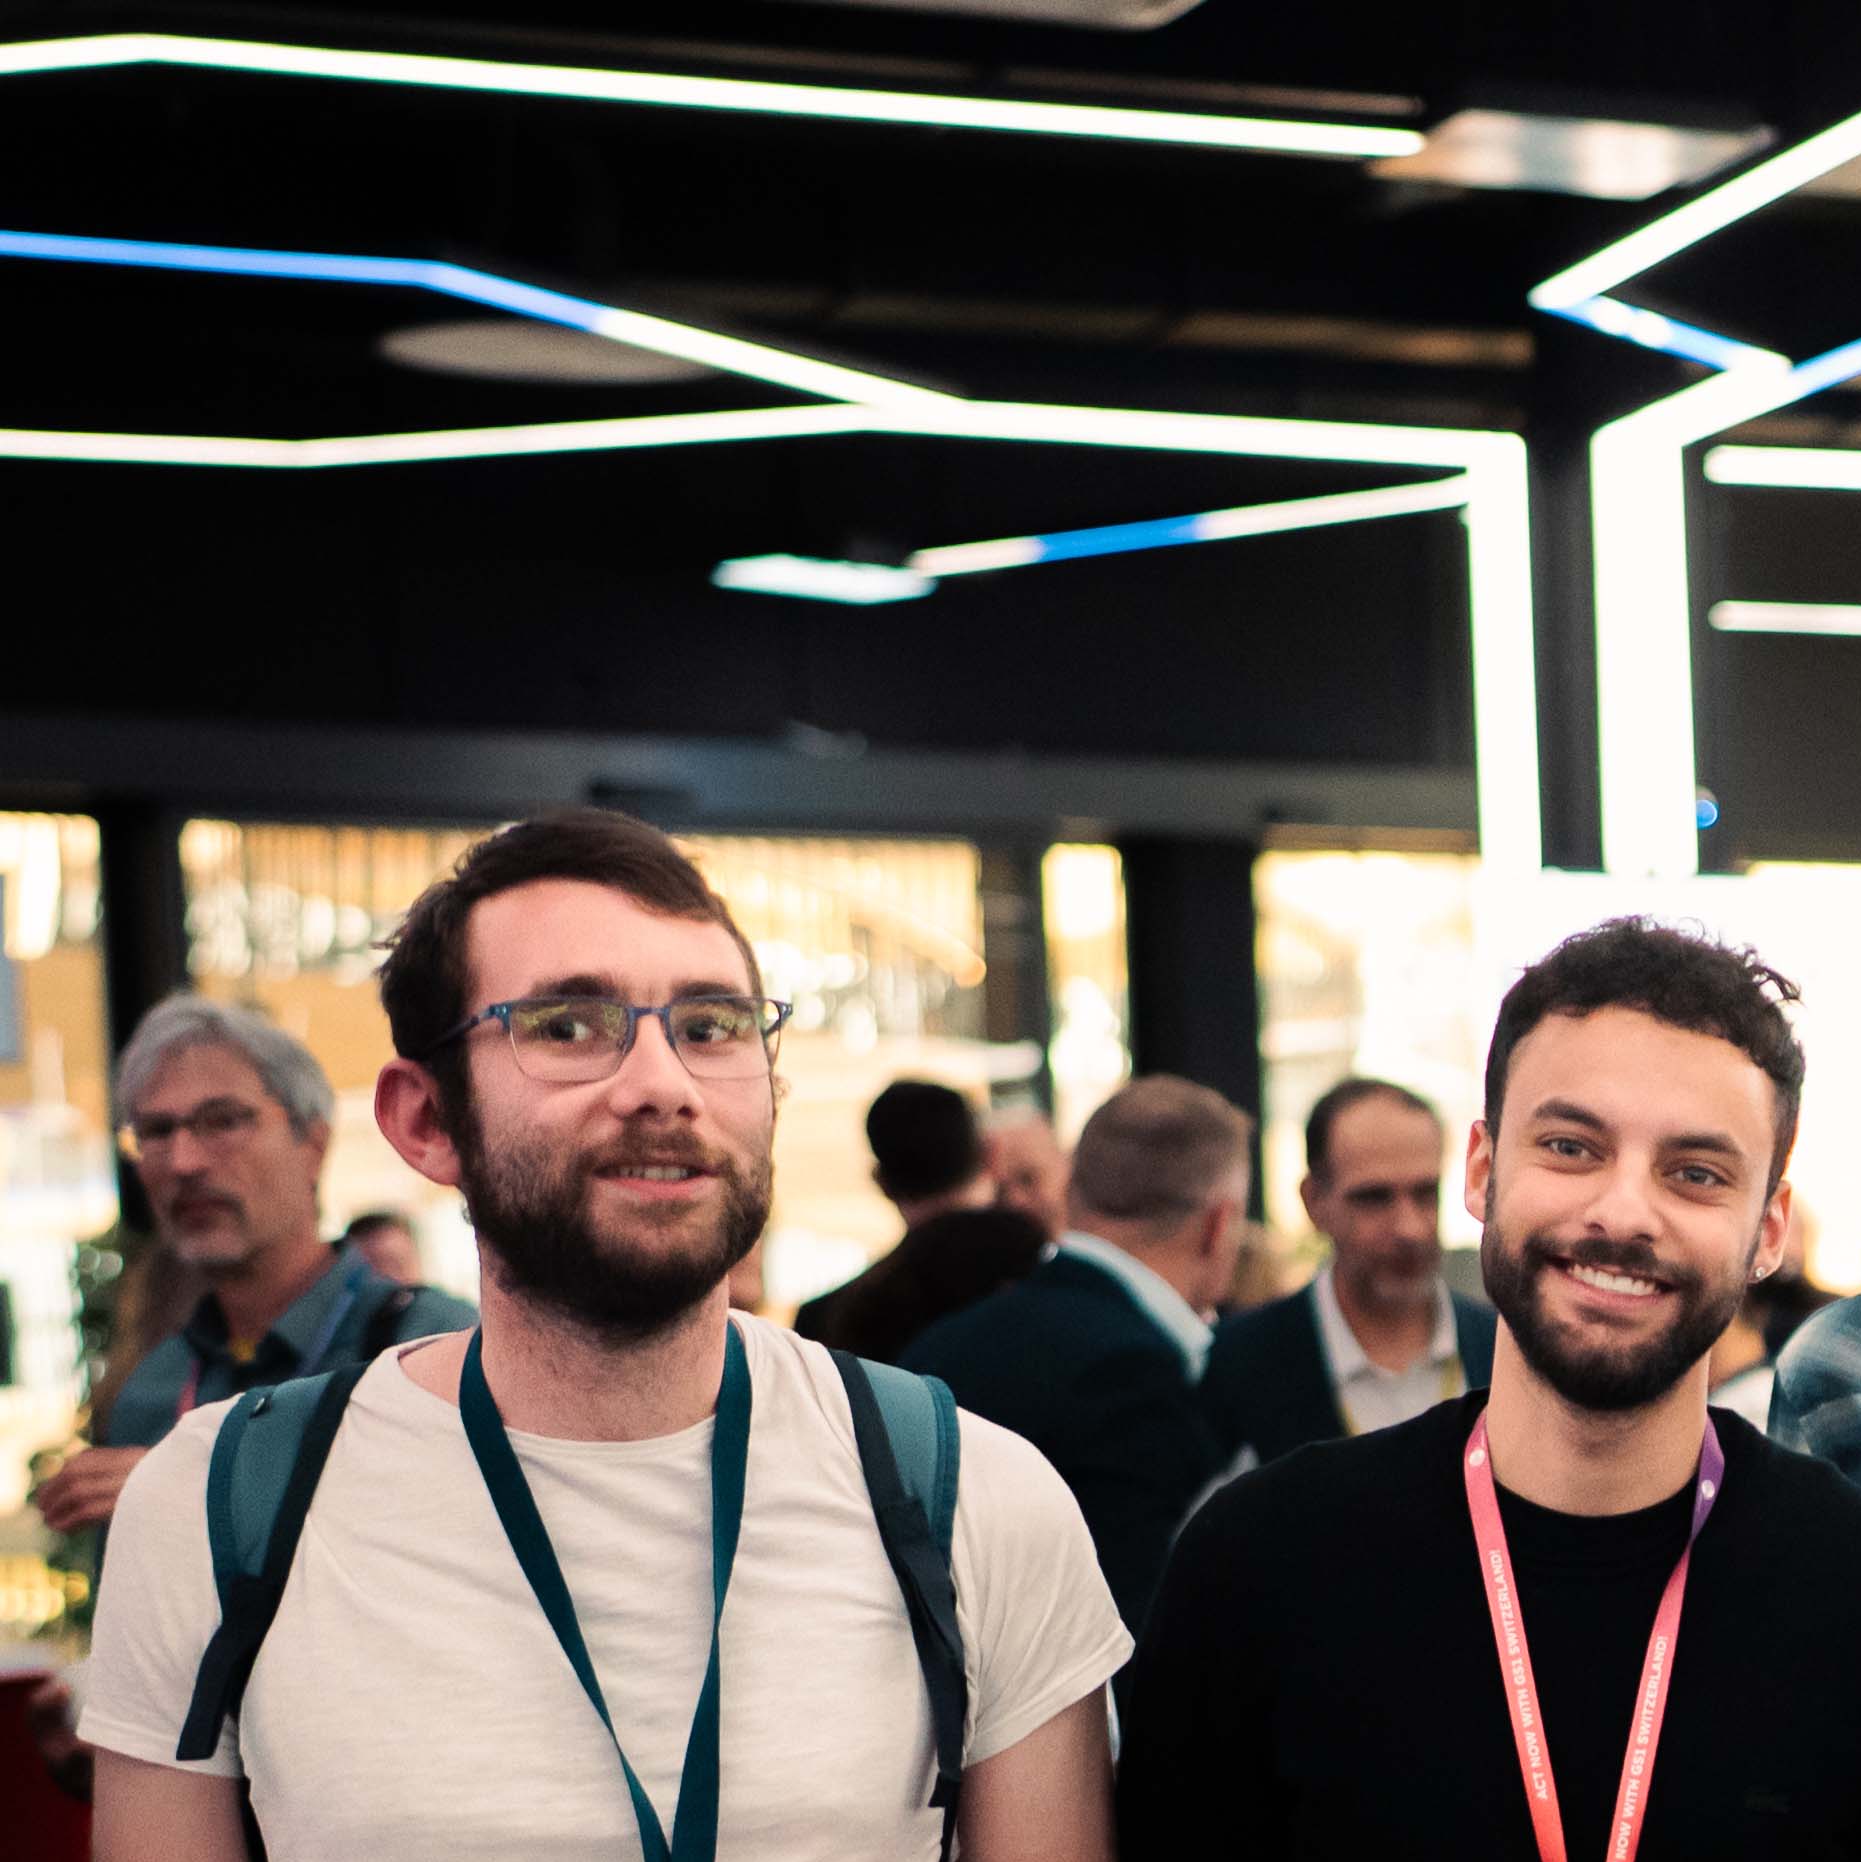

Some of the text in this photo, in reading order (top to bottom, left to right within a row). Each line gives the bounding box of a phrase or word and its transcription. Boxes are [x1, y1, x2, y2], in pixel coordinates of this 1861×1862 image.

[1488, 1548, 1548, 1800] ACT NOW WITH GS1 SWITZERLAND!
[1637, 1635, 1668, 1745] SWITZERLAND!
[1630, 1748, 1647, 1776] GS1
[1622, 1778, 1641, 1818] WITH
[1615, 1821, 1632, 1860] NOW
